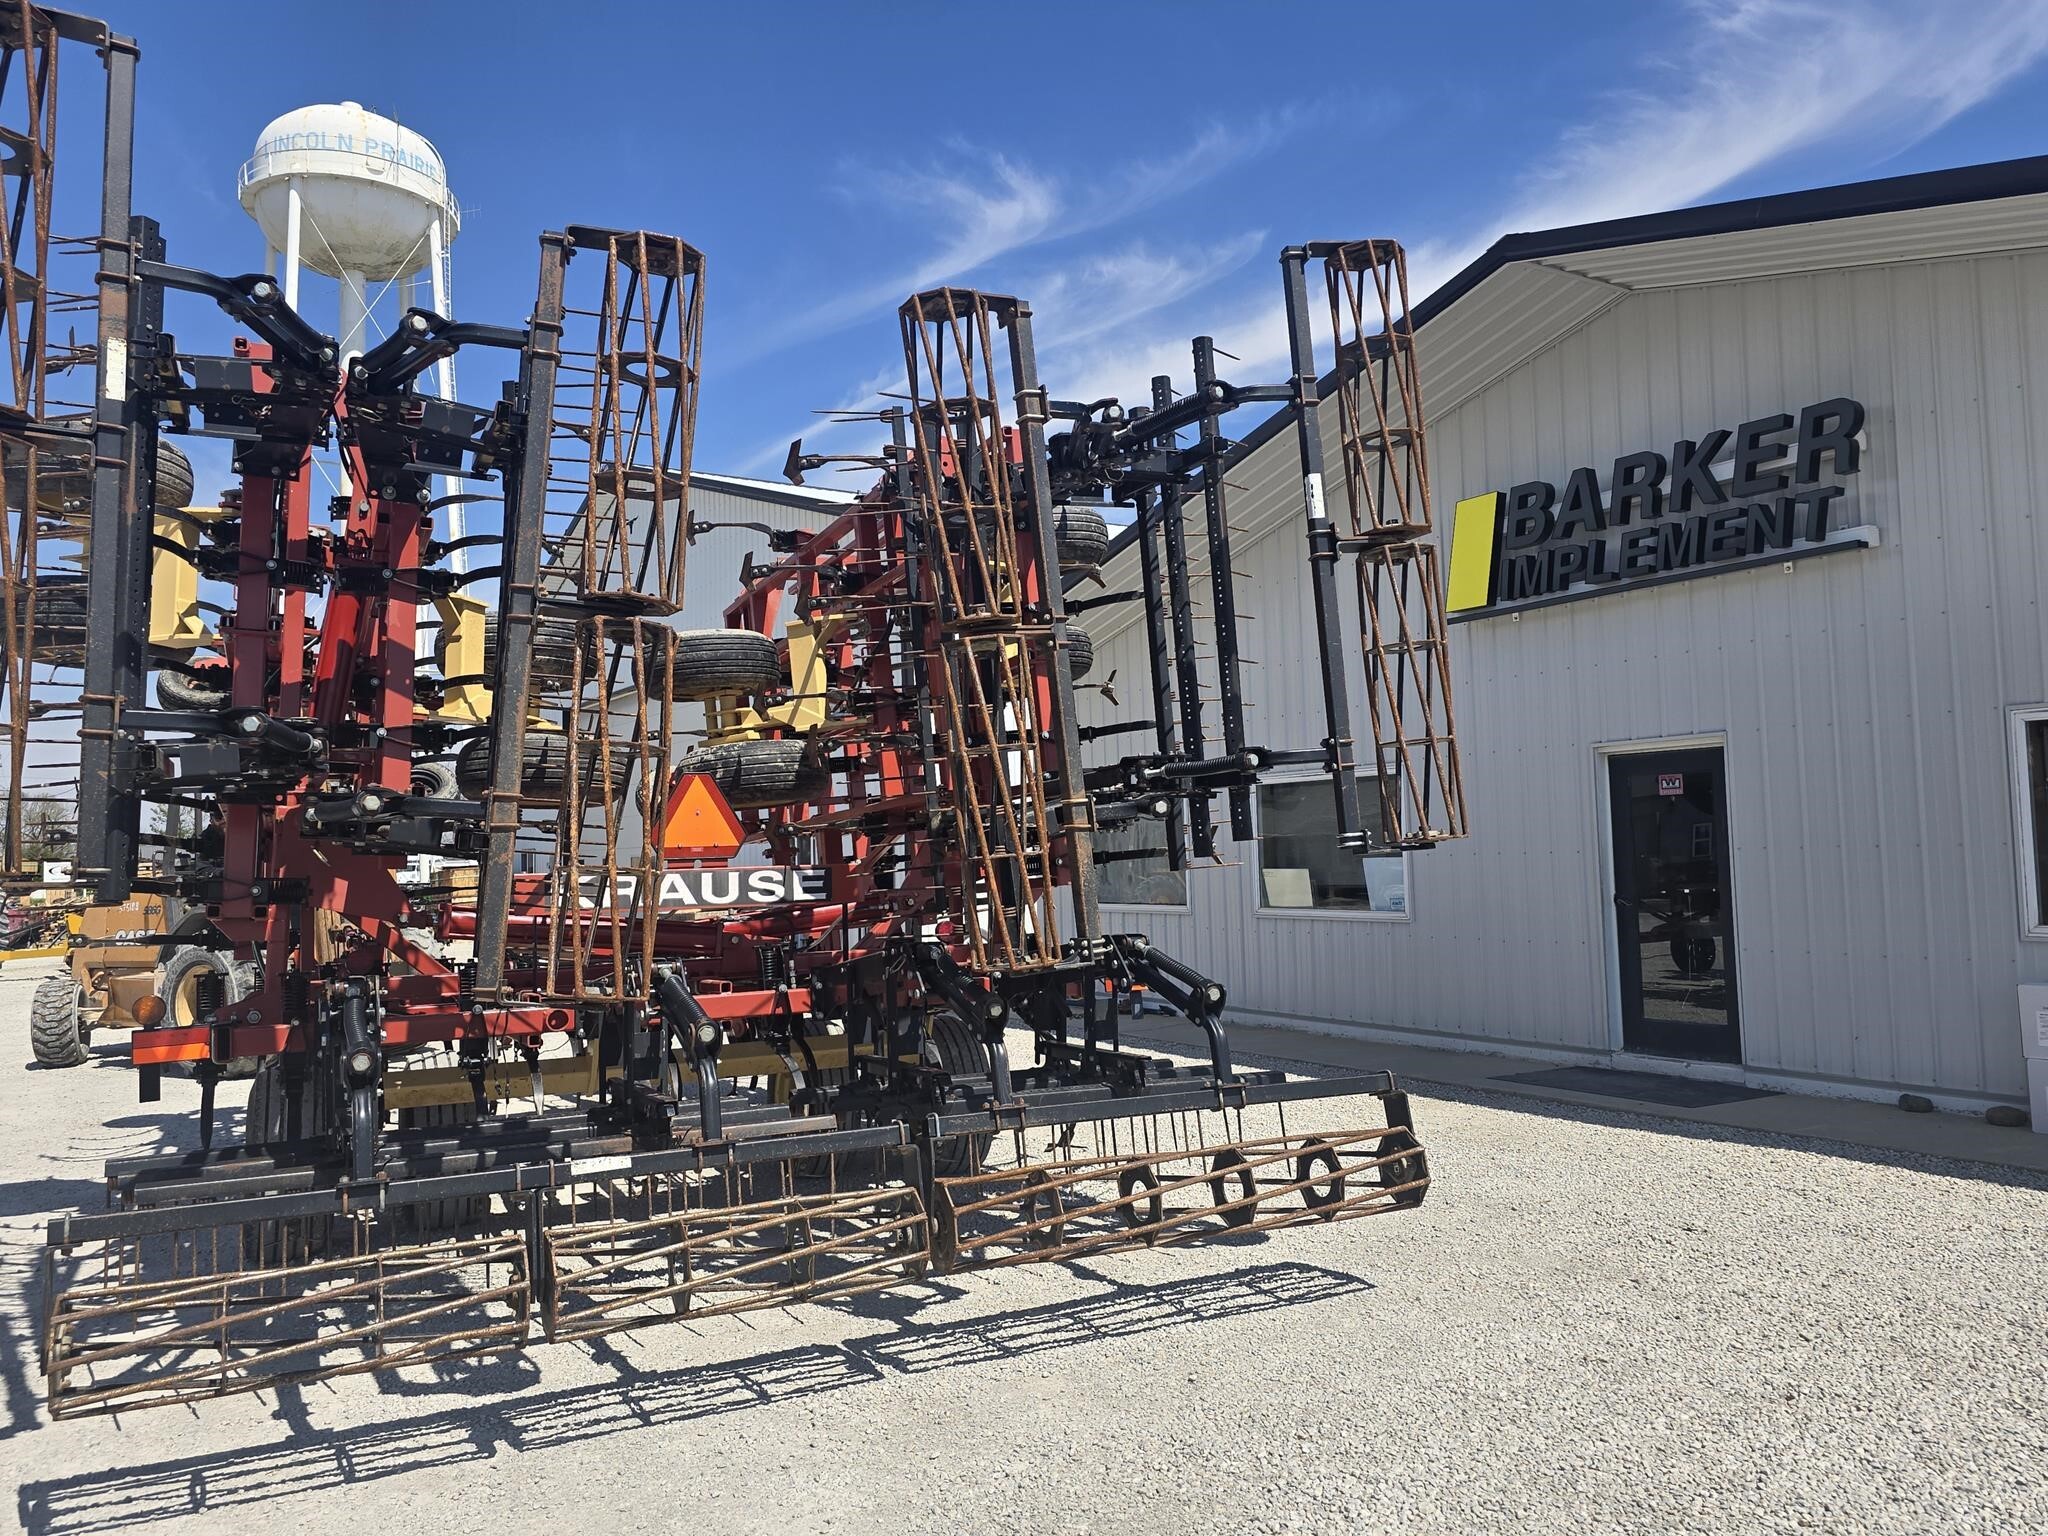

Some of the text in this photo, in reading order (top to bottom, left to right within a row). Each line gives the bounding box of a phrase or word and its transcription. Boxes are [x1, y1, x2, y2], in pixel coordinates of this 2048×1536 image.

[263, 131, 441, 181] LINCOLN PRAIRIE
[1505, 397, 1866, 550] BARKER
[1500, 485, 1846, 602] IMPLEMENT
